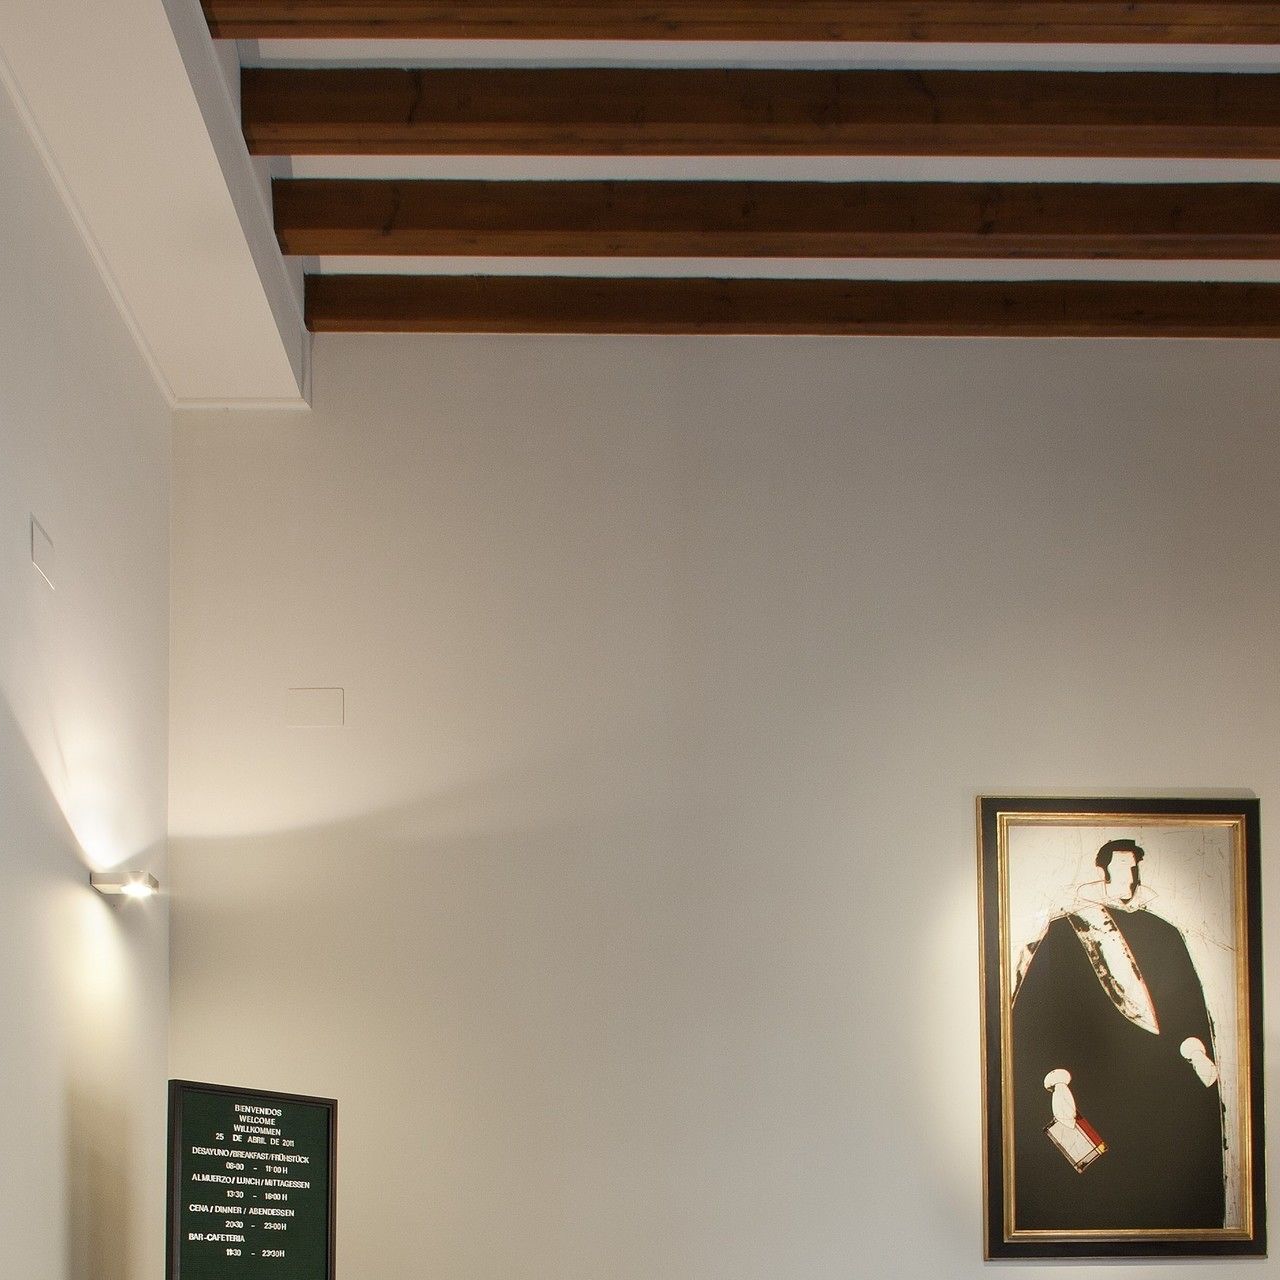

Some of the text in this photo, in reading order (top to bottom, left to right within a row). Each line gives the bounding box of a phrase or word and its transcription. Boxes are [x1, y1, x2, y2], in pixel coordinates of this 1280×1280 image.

[234, 1104, 282, 1117] BIENVENIDOS
[239, 1114, 276, 1126] WELCOME
[233, 1124, 281, 1136] WILLKOMMEN
[215, 1132, 295, 1147] 25 DE ABRIL DE 2011
[189, 1203, 209, 1213] CENA
[214, 1205, 242, 1214] DINNER
[248, 1207, 295, 1217] ABENDESSEN
